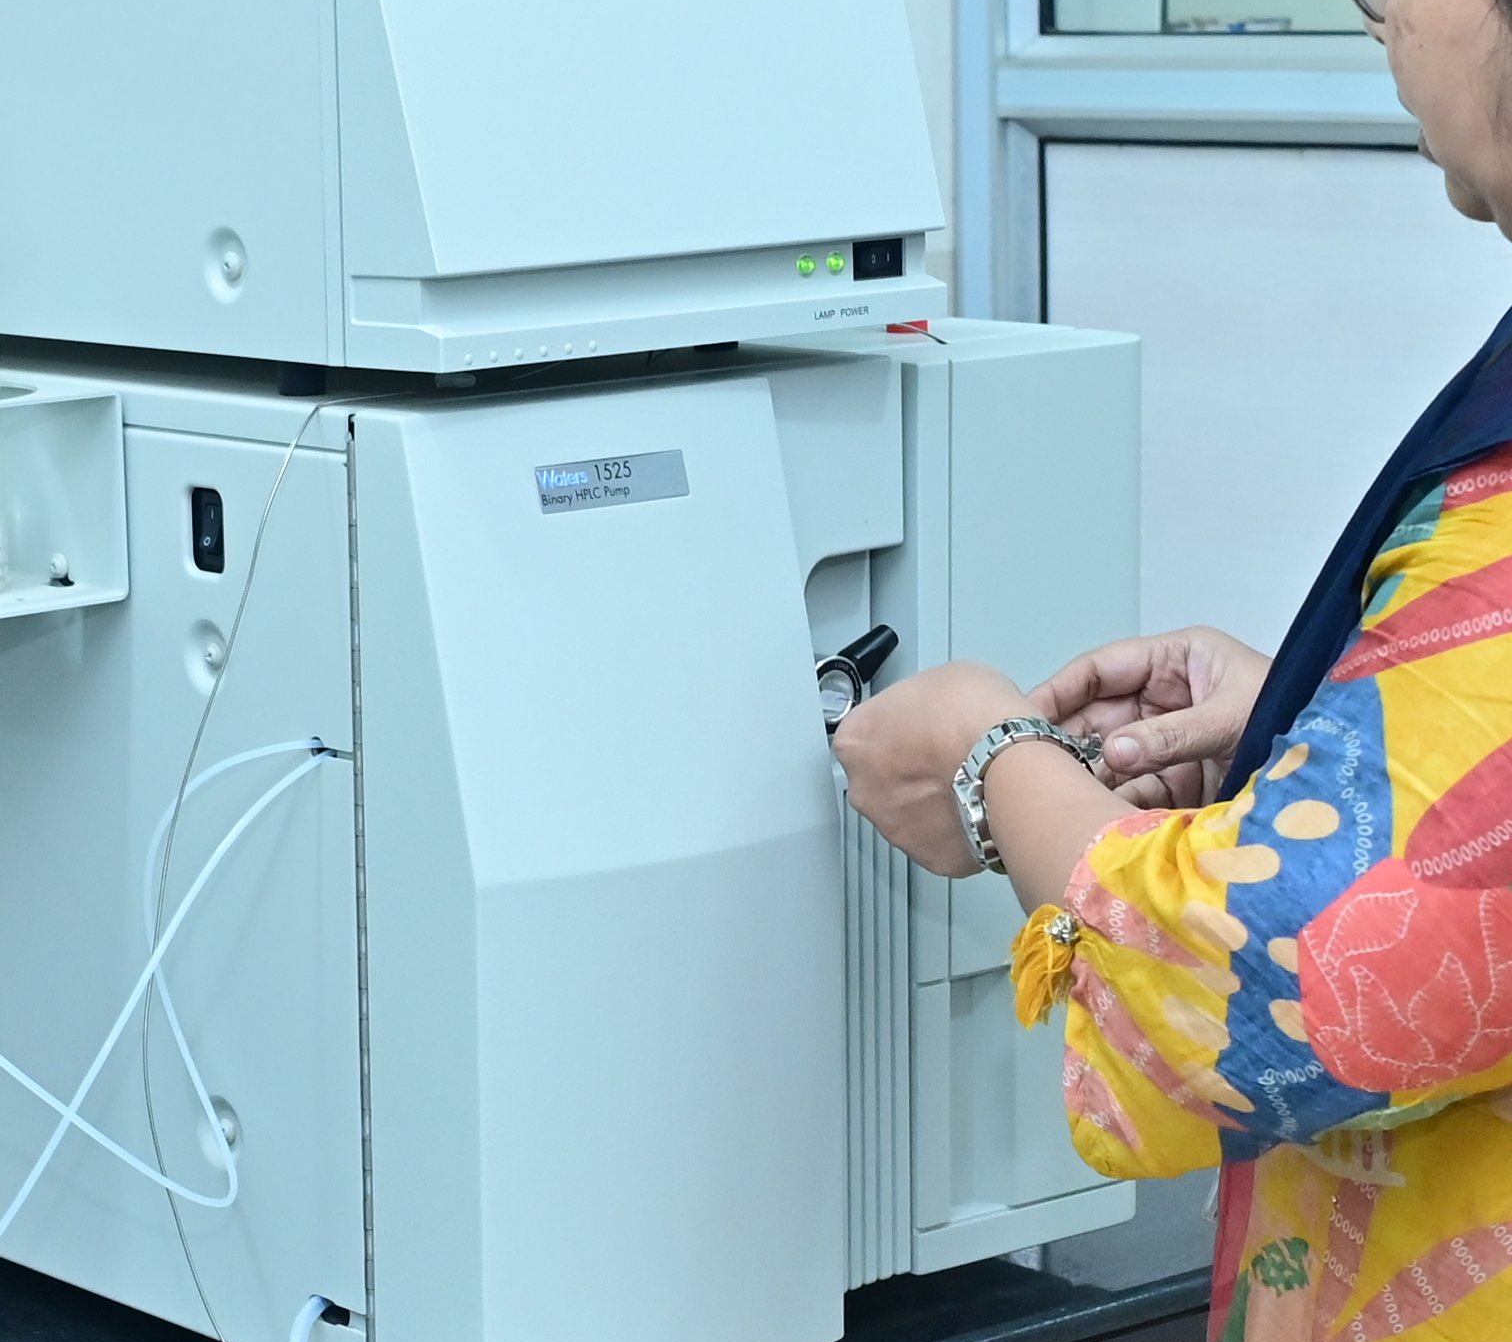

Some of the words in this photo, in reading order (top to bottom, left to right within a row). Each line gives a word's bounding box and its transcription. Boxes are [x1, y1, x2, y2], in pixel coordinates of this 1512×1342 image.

[814, 309, 836, 320] LAMP
[840, 306, 869, 318] POWER
[536, 469, 589, 489] Waters
[594, 461, 632, 482] 1525
[542, 494, 573, 506] Binary
[576, 487, 601, 501] HPLC
[604, 485, 630, 498] Pump
